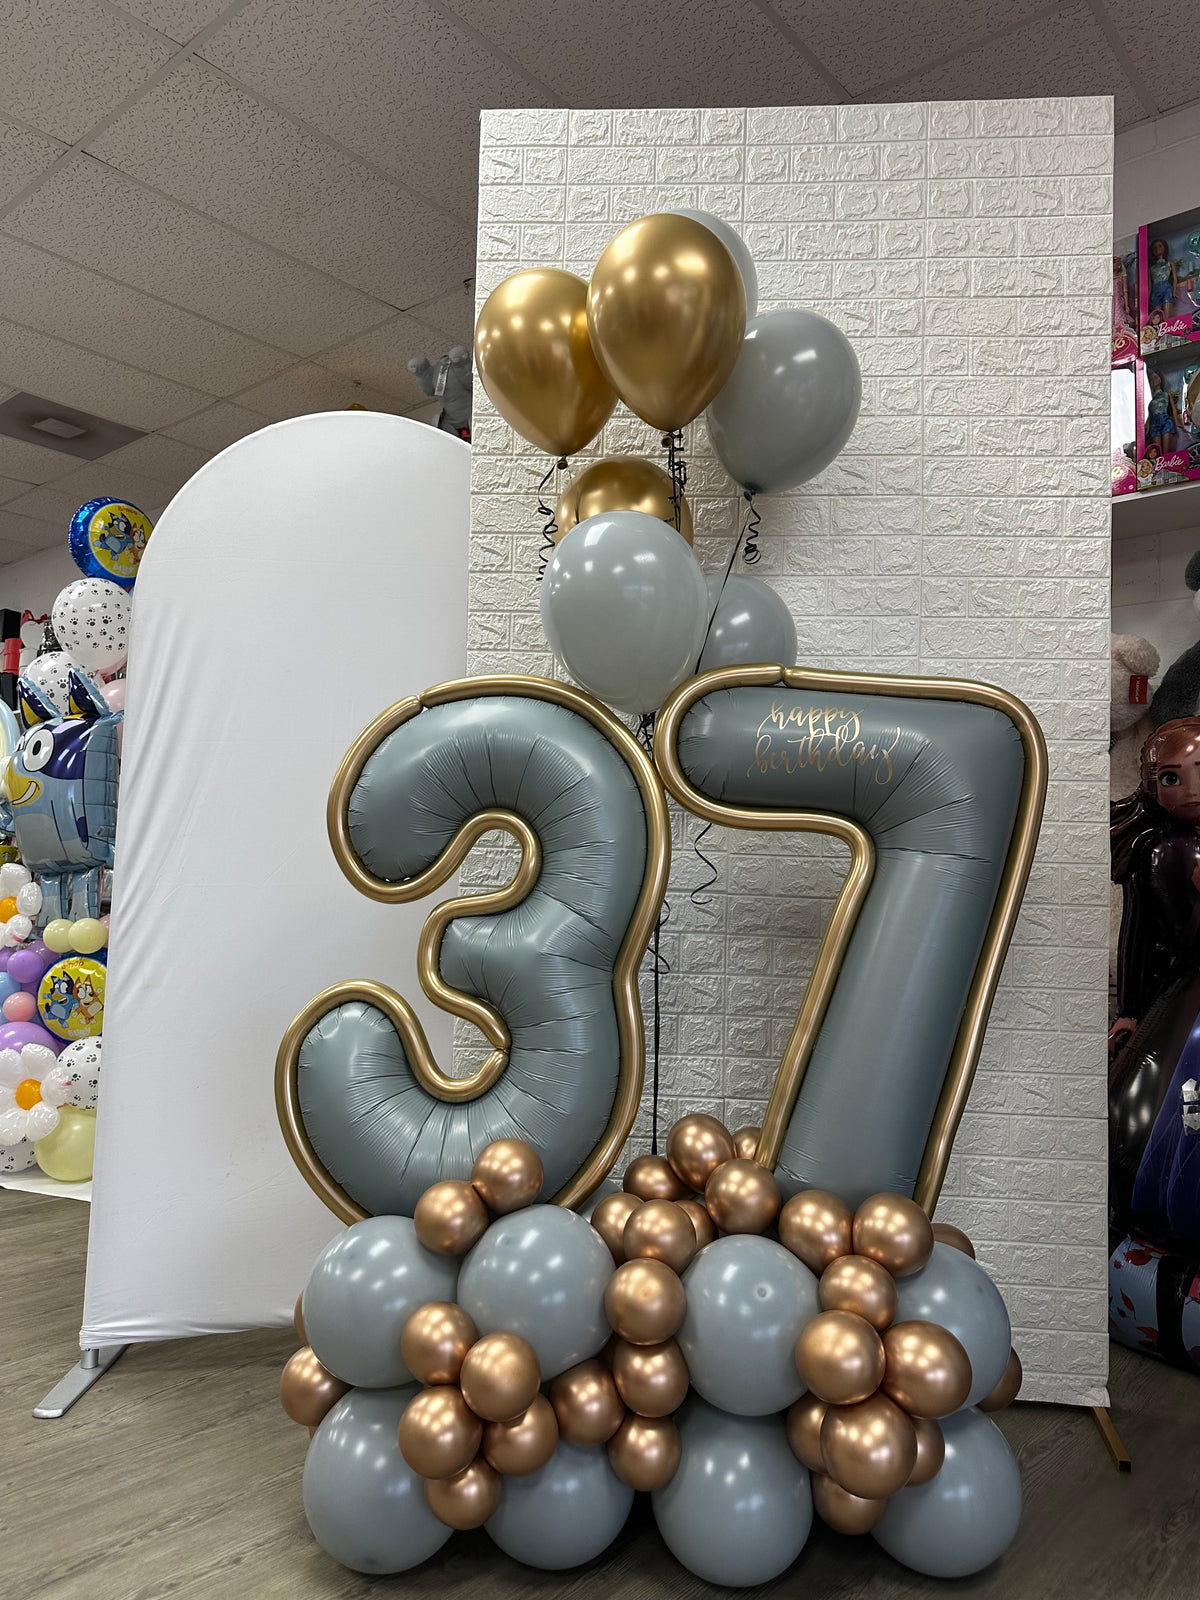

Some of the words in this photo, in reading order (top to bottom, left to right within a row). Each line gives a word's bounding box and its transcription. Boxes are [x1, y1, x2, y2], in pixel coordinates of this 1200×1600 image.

[1158, 320, 1187, 337] Barbie
[1154, 455, 1184, 471] Barbie
[757, 700, 870, 742] happy
[747, 725, 900, 785] birthday
